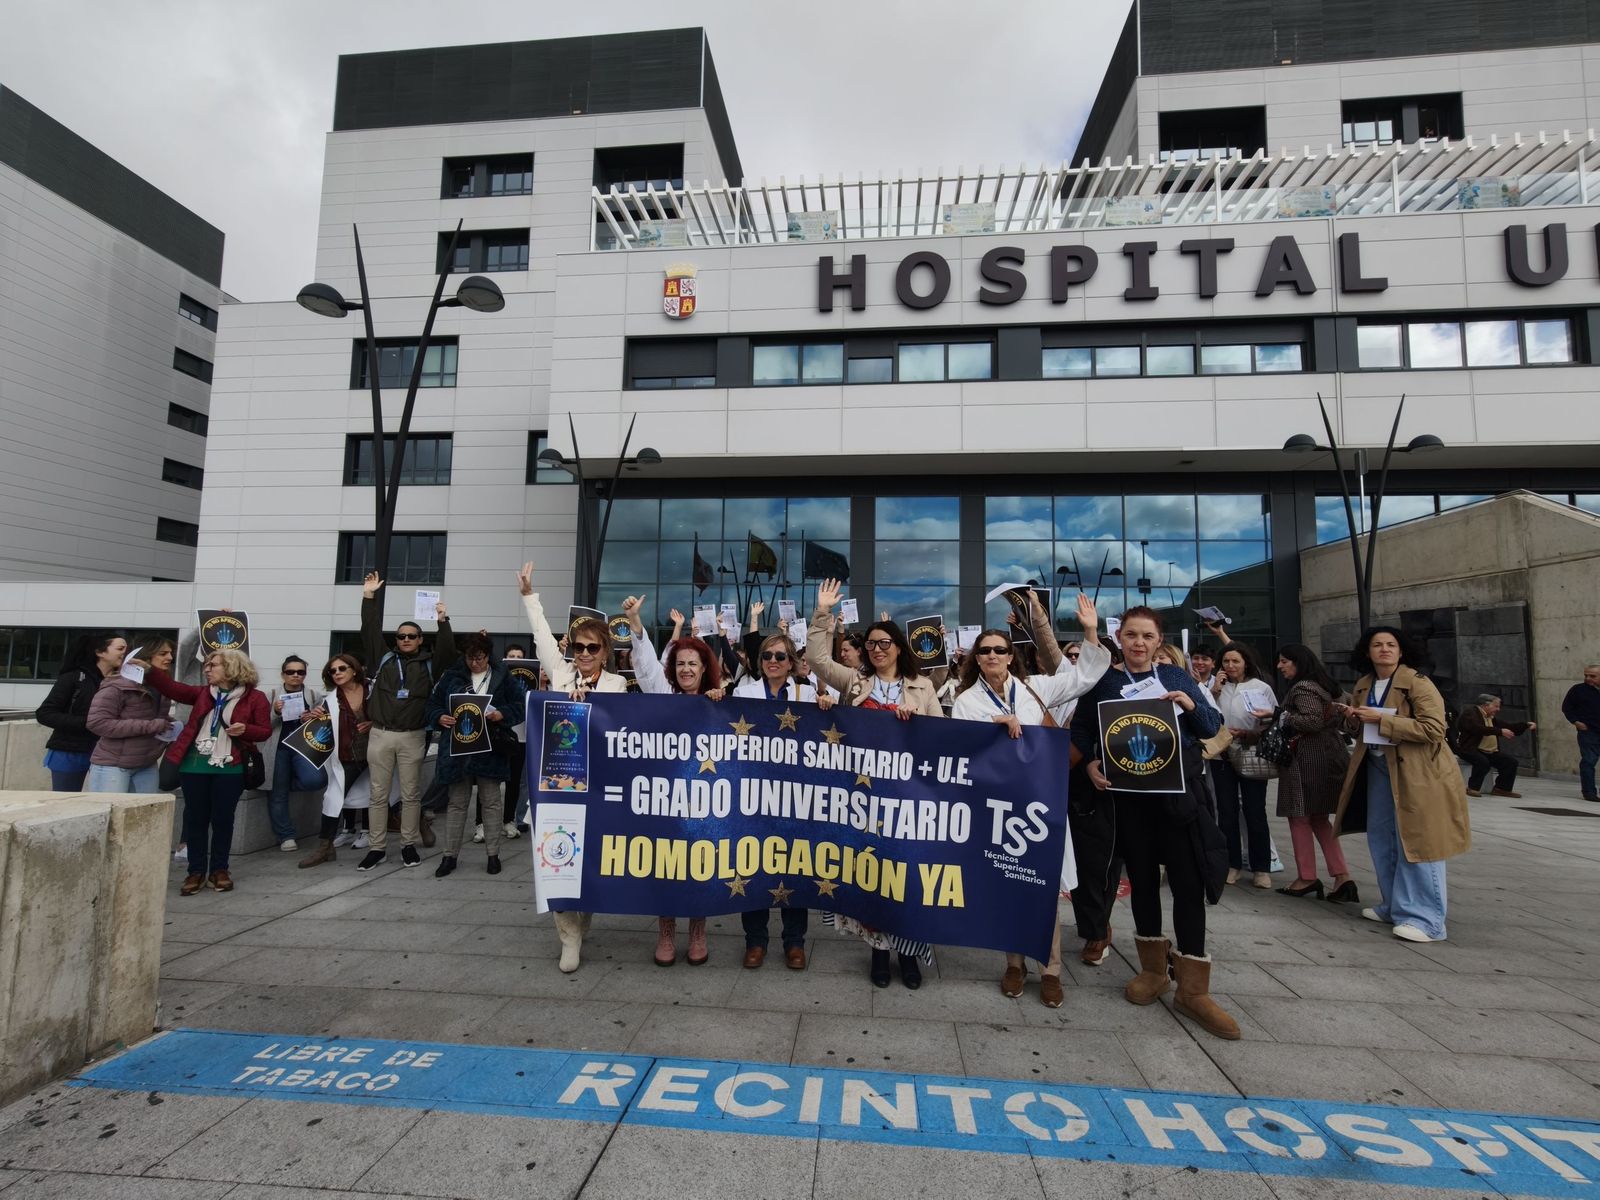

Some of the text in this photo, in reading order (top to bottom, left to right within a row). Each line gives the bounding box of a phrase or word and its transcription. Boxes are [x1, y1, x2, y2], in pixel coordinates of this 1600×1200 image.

[819, 222, 1600, 312] HOSPITAL U
[1110, 716, 1166, 734] YO NO APRIETO
[605, 727, 972, 786] TÉCNICO SUPERIOR SANITARIO + U.E.
[1120, 756, 1164, 771] BOTONES
[604, 775, 972, 843] = GRADO UNIVERSITARIO
[986, 798, 1050, 856] TSS
[984, 850, 1019, 863] Técnicos
[993, 860, 1036, 875] Superiores
[600, 835, 965, 908] HOMOLOGACIÓN YA
[1005, 870, 1046, 885] Sanitarios
[253, 1043, 444, 1068] LIBRE DE
[231, 1066, 400, 1091] TABACO
[557, 1062, 1089, 1142] RECINTO
